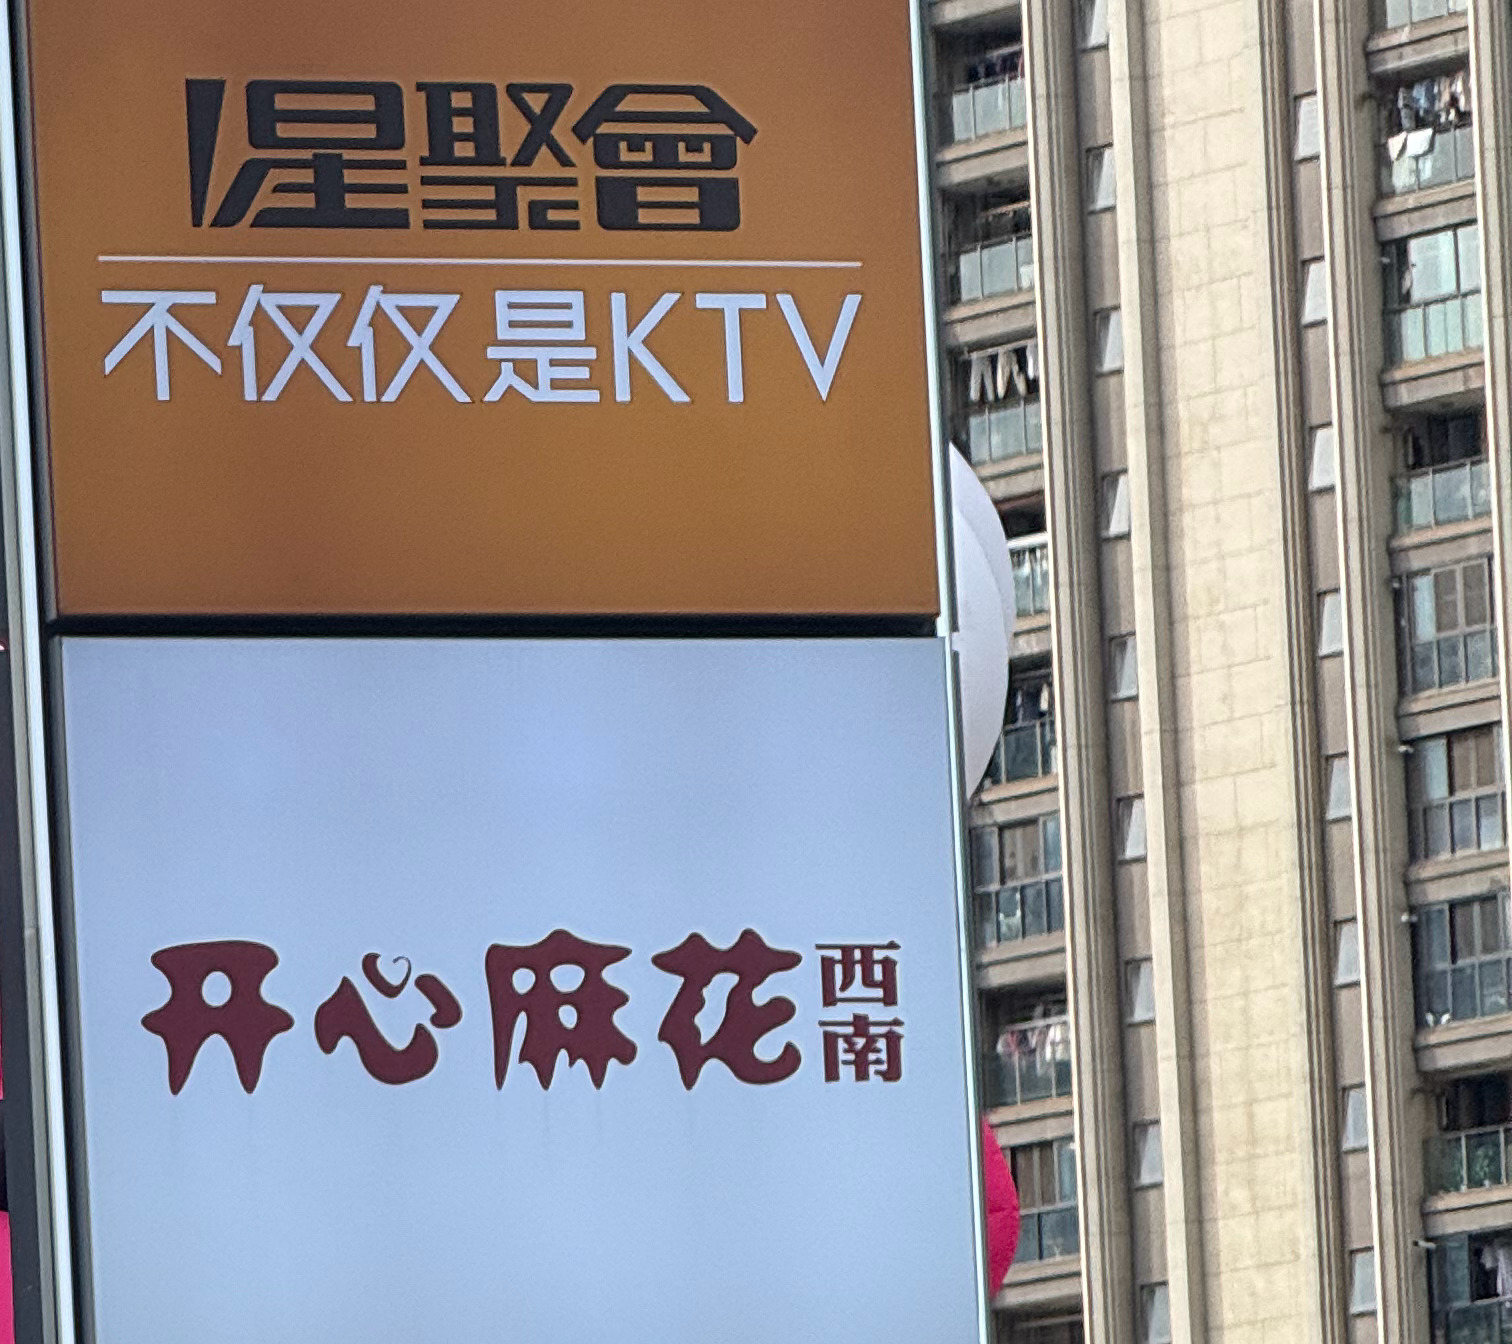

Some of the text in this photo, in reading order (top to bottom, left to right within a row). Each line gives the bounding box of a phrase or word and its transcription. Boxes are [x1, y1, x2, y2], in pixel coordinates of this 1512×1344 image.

[185, 78, 758, 232] 星聚會
[100, 284, 863, 403] 不仅仅是KTV
[140, 928, 803, 1096] 开心麻花
[814, 940, 904, 1083] 西南
